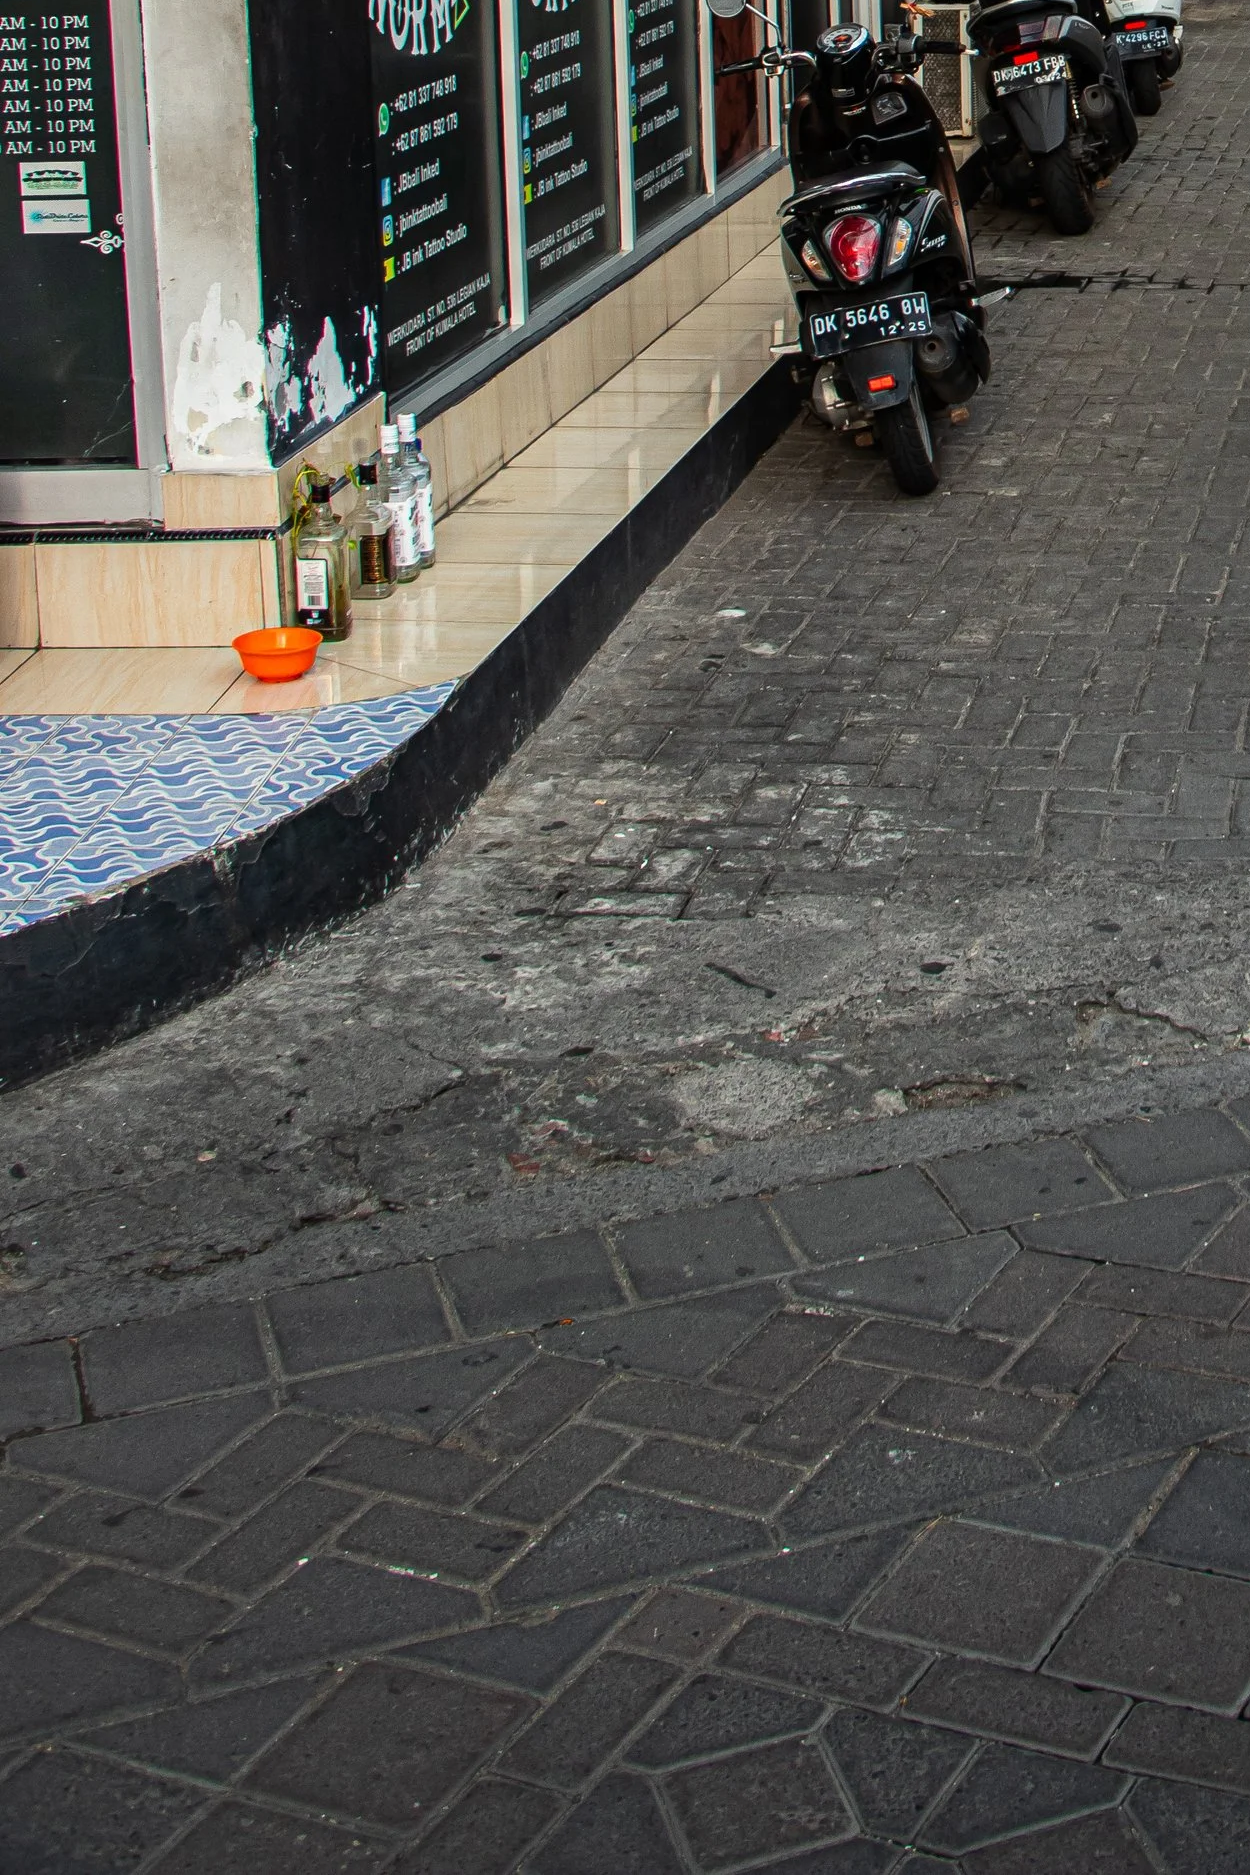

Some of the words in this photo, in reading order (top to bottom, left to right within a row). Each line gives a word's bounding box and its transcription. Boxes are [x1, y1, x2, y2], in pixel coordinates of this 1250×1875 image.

[0, 16, 26, 30] AM
[41, 16, 59, 29] 10
[62, 15, 89, 28] PM
[0, 38, 27, 51] AM
[42, 37, 60, 50] 10
[63, 36, 90, 49] PM
[1125, 31, 1148, 42] 4296
[0, 58, 28, 72] AM
[43, 58, 61, 71] 10
[65, 57, 91, 70] PM
[993, 69, 1006, 82] DK
[1013, 61, 1041, 78] 6473
[1043, 55, 1066, 70] FBB
[1, 79, 30, 92] AM
[45, 79, 62, 91] 10
[66, 78, 93, 91] PM
[395, 92, 408, 112] +62
[408, 89, 417, 108] 81
[418, 84, 430, 105] 337
[431, 79, 444, 99] 748
[445, 74, 457, 94] 918
[3, 100, 31, 113] AM
[46, 99, 63, 112] 10
[67, 98, 94, 112] PM
[4, 120, 32, 133] AM
[47, 120, 65, 133] 10
[68, 119, 95, 132] PM
[396, 132, 409, 151] +62
[410, 128, 419, 147] 87
[420, 123, 432, 143] 861
[433, 117, 446, 138] 592
[446, 112, 458, 132] 179
[6, 141, 33, 154] AM
[48, 140, 66, 153] 10
[69, 140, 96, 153] PM
[398, 166, 420, 194] JBbali
[420, 158, 440, 183] Inked
[834, 204, 862, 215] HONDA
[401, 251, 412, 272] JB
[412, 245, 424, 266] ink
[424, 237, 445, 259] Tattoo
[446, 223, 467, 247] Studio
[814, 314, 837, 335] DK
[845, 304, 890, 327] 5646
